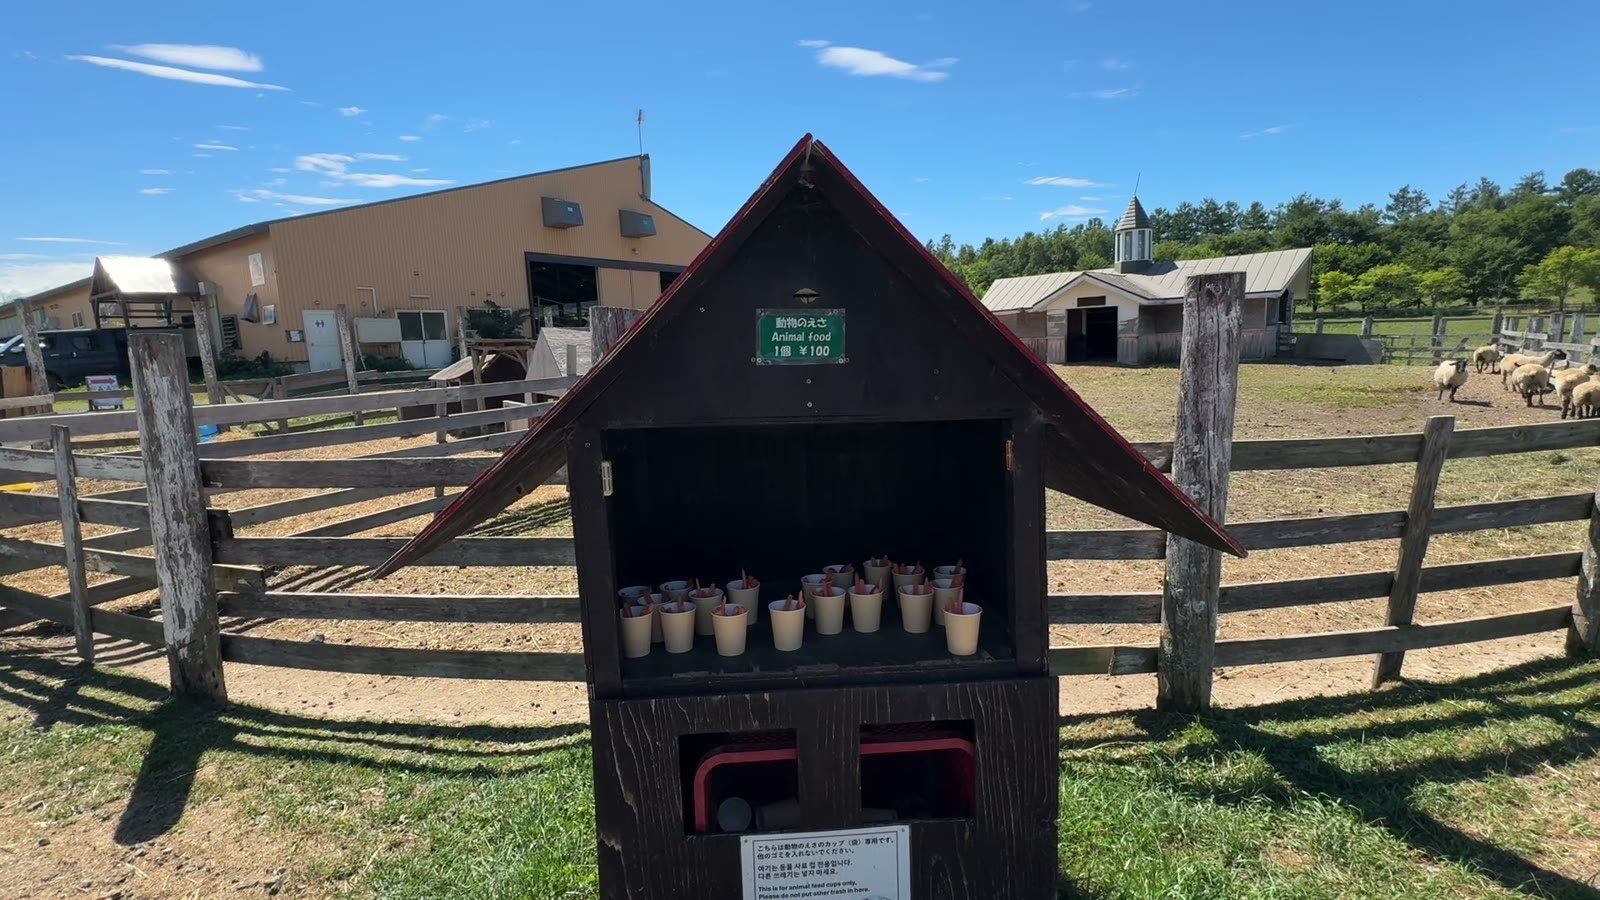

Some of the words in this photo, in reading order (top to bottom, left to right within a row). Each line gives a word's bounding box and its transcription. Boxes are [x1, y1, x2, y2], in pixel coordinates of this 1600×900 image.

[776, 317, 826, 328] 動物のえさ
[772, 332, 804, 342] Animal
[808, 332, 832, 342] food
[775, 346, 792, 356] 1個
[800, 346, 830, 356] ¥100
[757, 848, 854, 860] 他のゴミを入れないでください。
[758, 864, 778, 872] 여기는
[773, 871, 800, 879] 쓰레기는
